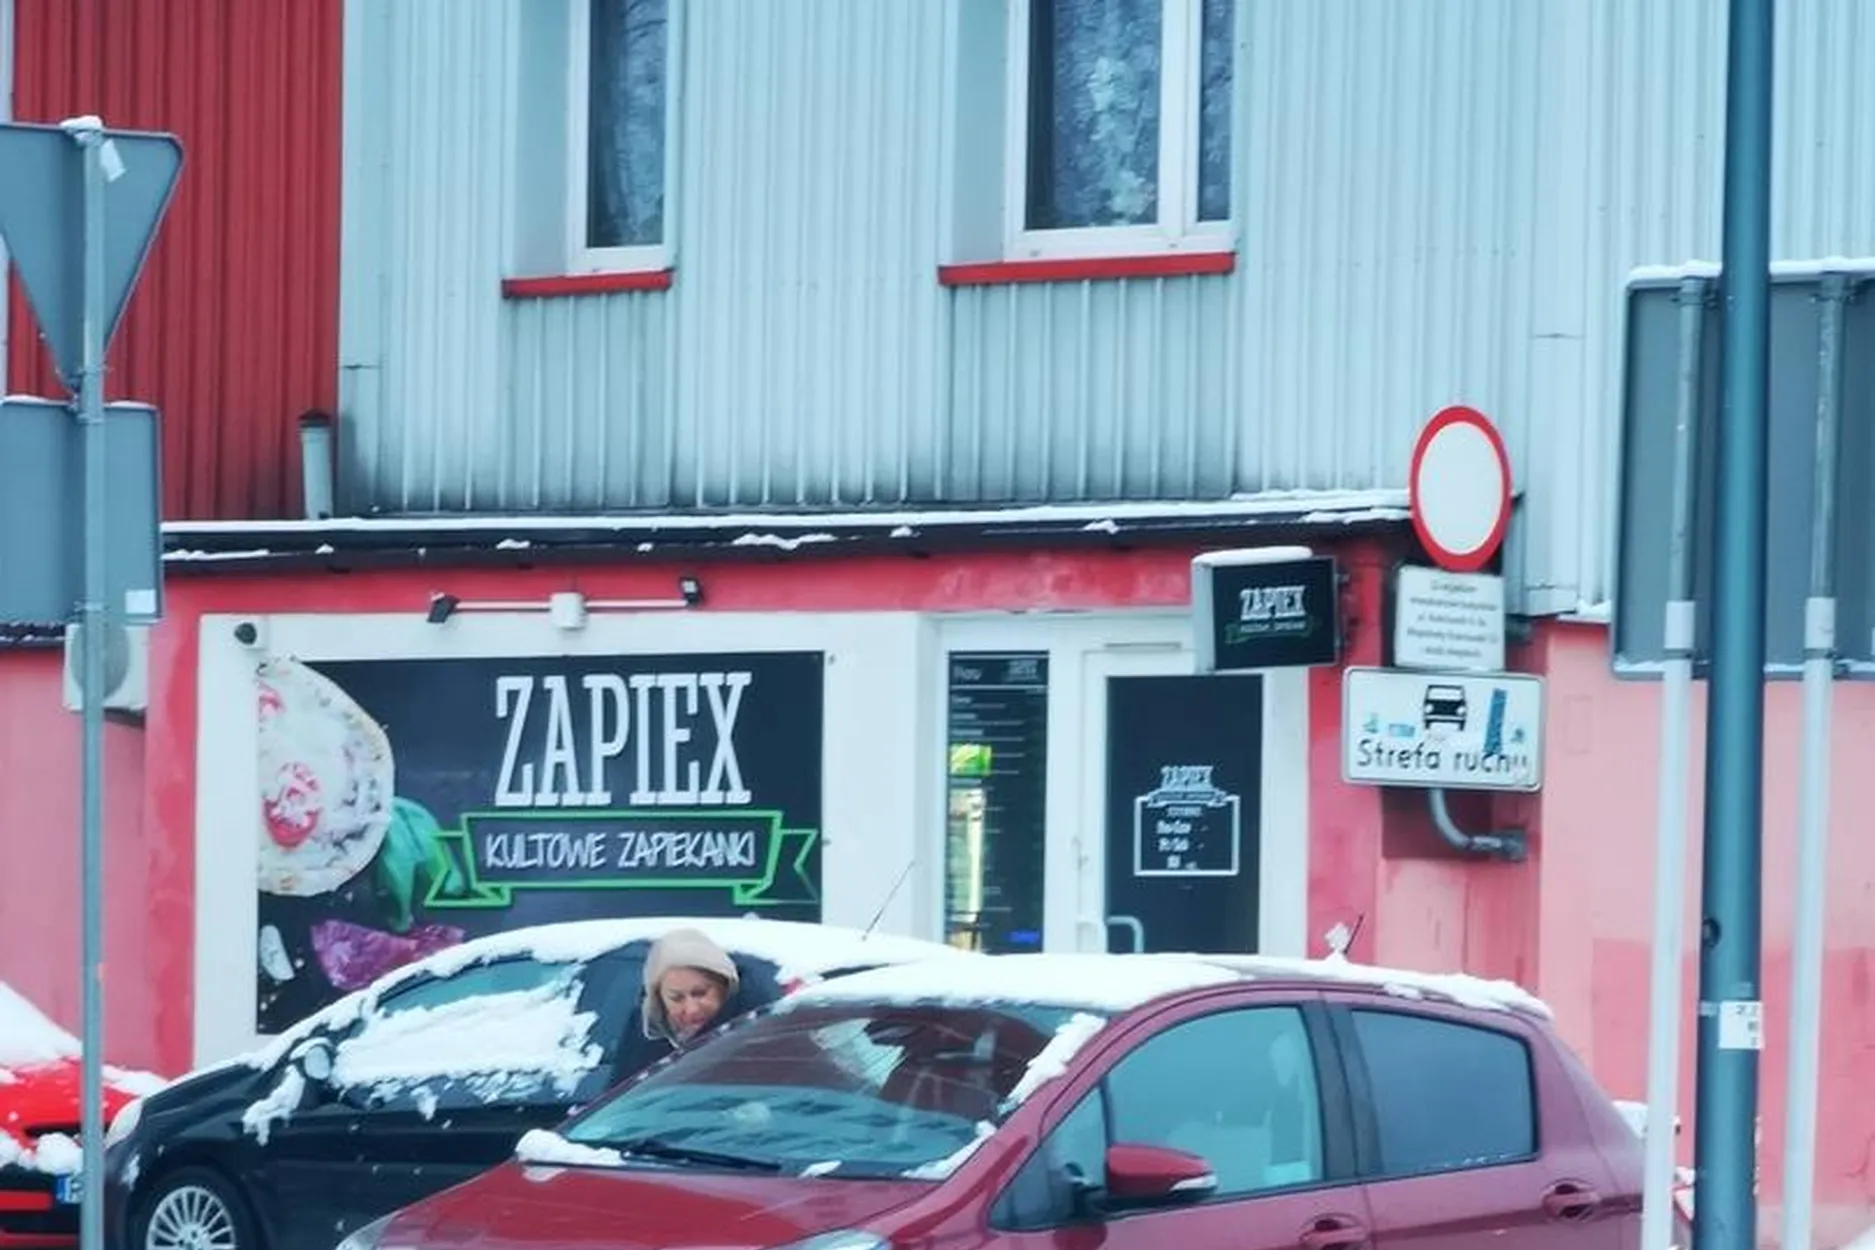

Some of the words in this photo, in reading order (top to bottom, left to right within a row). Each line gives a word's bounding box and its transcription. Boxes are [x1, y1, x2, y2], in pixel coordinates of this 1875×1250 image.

[1240, 585, 1307, 621] ZAPIEX
[495, 672, 752, 807] ZAPIEX
[1357, 738, 1441, 769] Strefa
[485, 833, 606, 869] KULTOWE
[617, 831, 755, 867] ZAPIEKANKI
